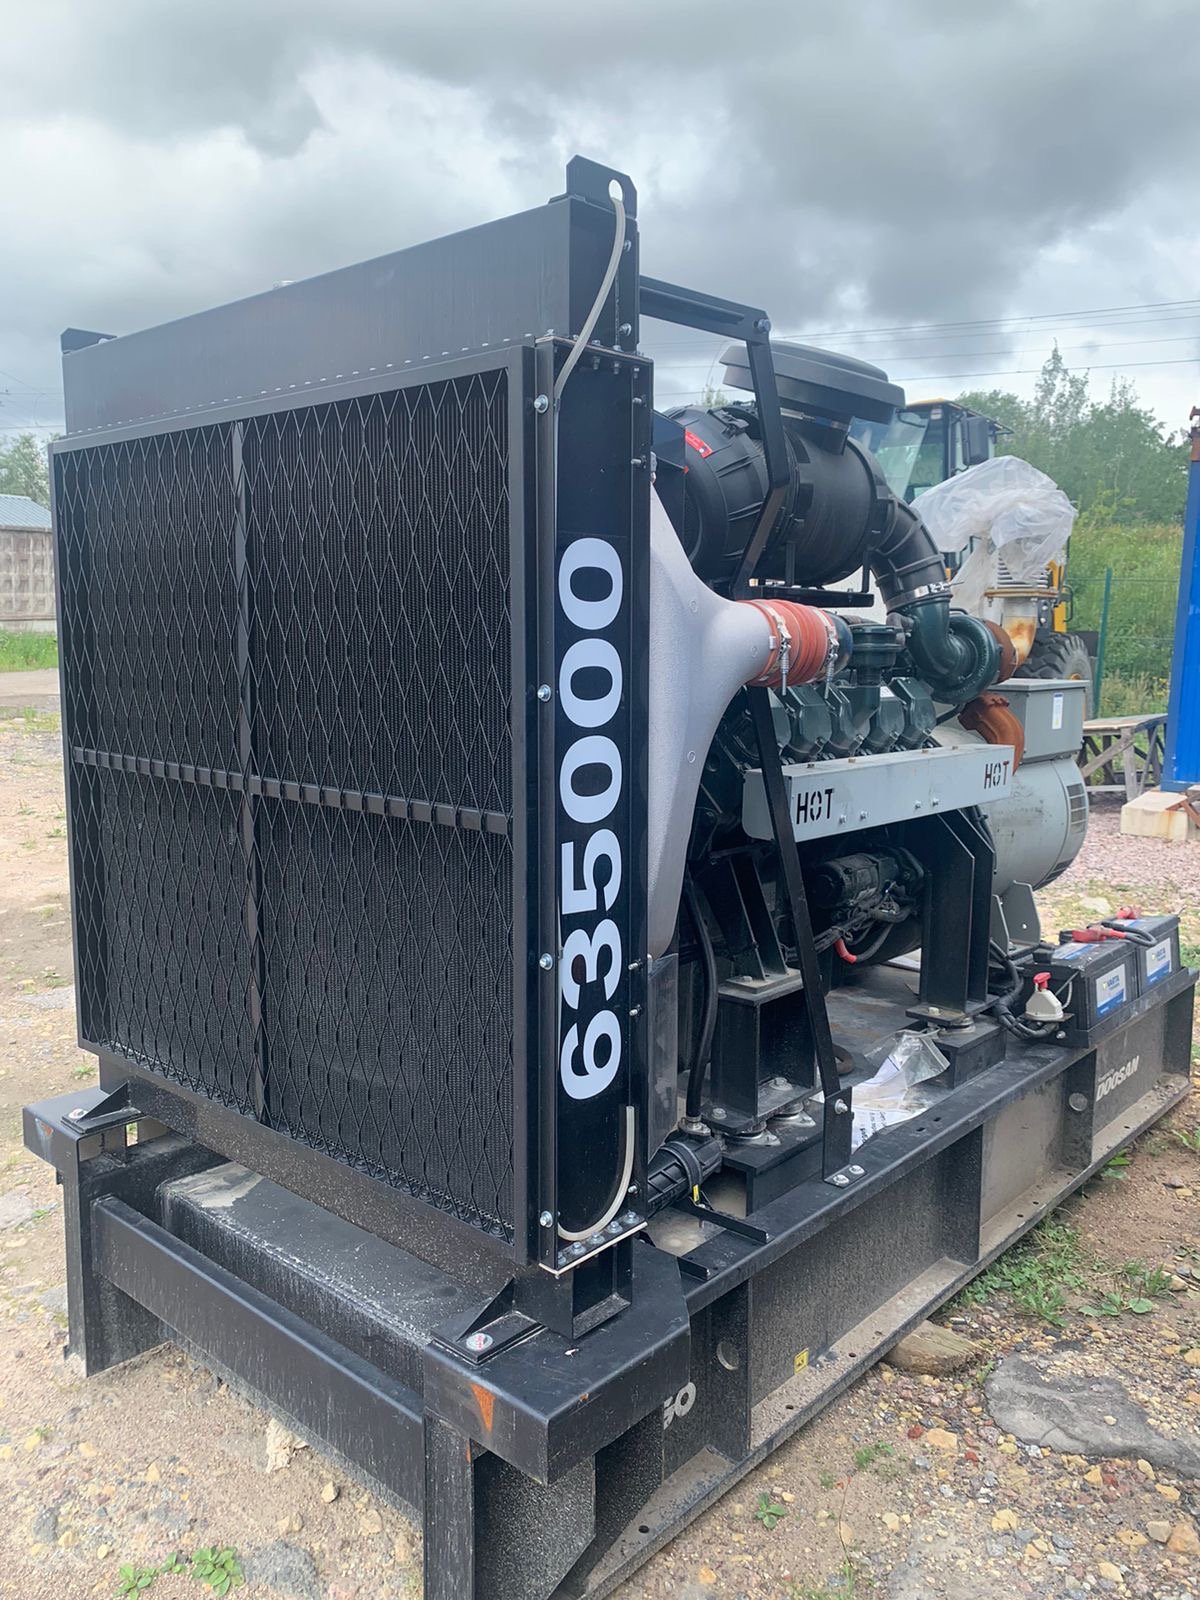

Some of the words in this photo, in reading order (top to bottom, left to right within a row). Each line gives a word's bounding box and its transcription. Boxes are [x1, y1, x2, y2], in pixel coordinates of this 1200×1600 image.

[984, 760, 1010, 789] HOT
[558, 537, 623, 1100] 635000
[796, 788, 834, 825] HOT
[1096, 1055, 1139, 1102] DOOSAN
